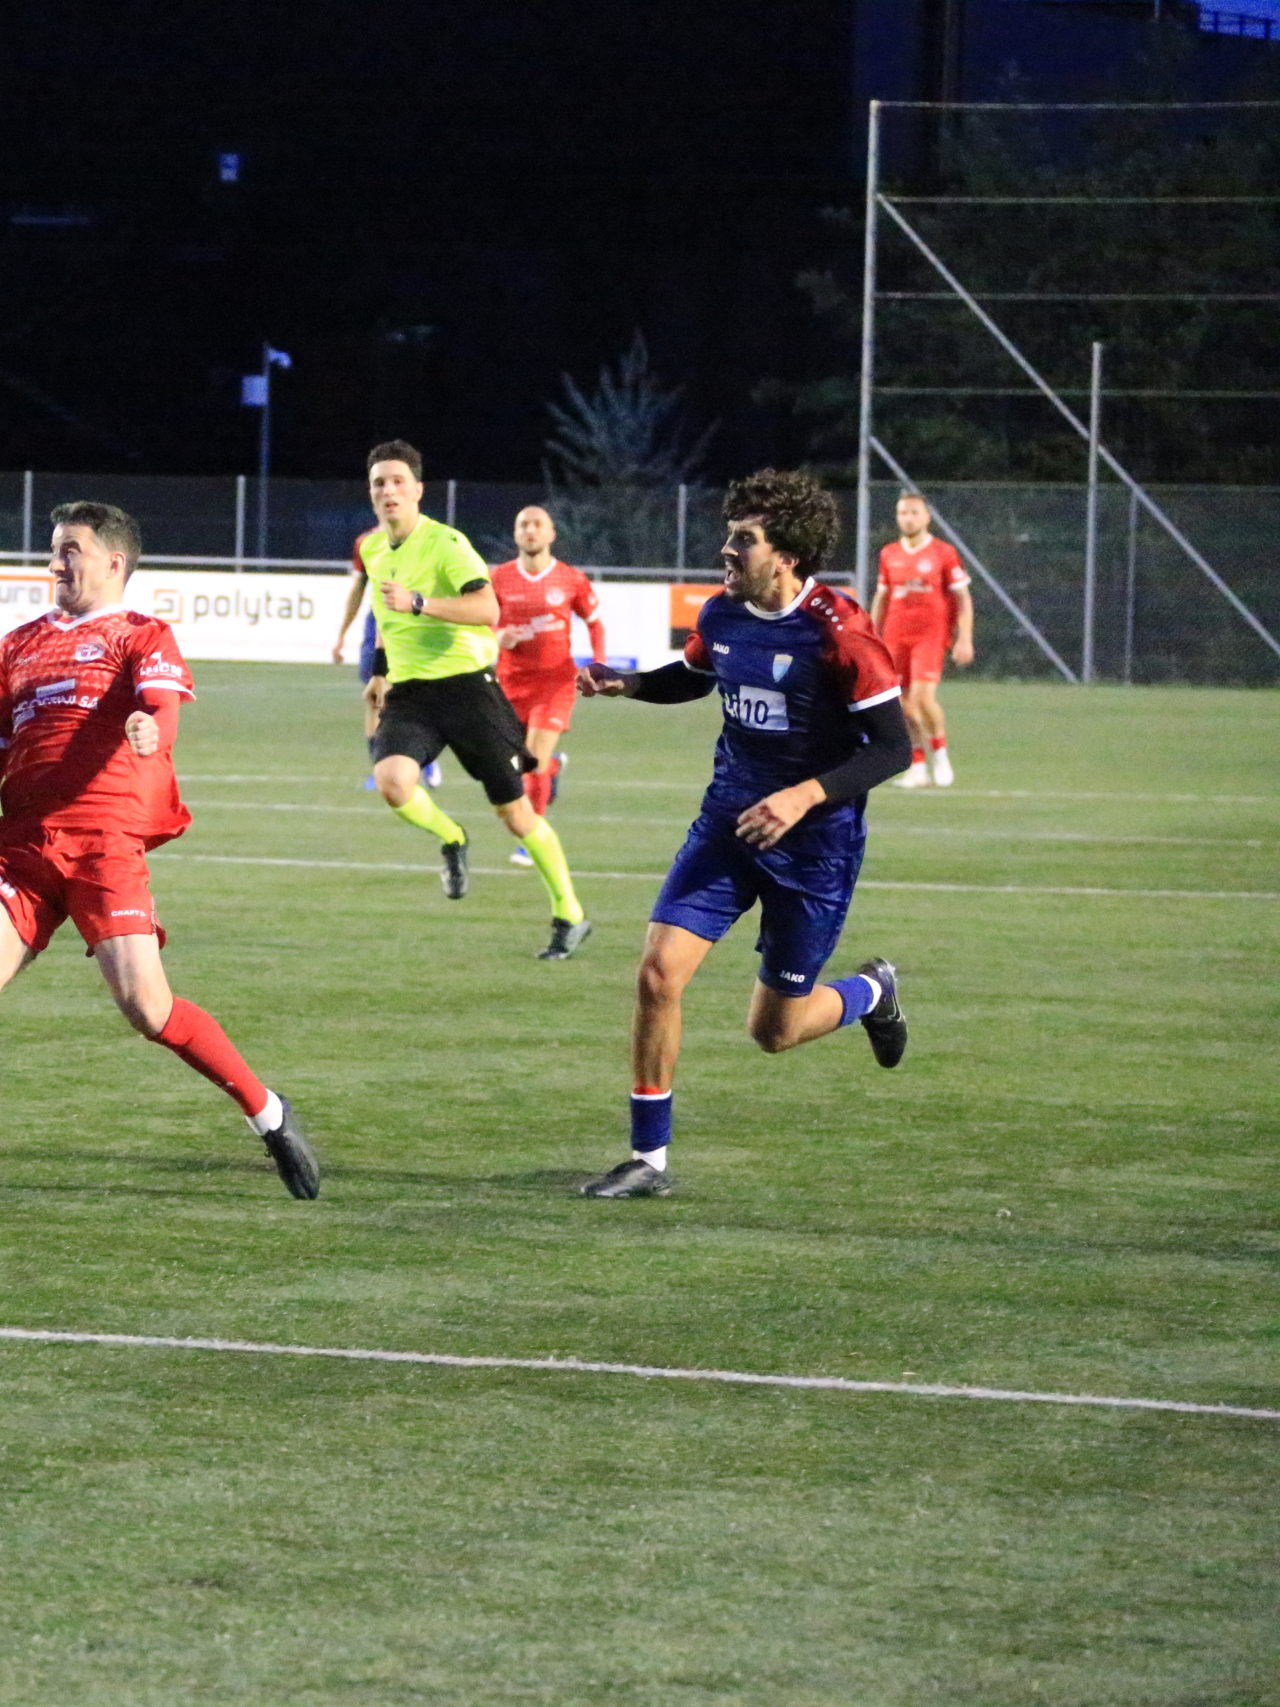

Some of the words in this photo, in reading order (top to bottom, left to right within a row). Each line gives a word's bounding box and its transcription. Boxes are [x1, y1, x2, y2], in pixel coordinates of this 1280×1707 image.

[193, 589, 315, 626] polytab
[712, 642, 730, 655] JAKO
[780, 970, 805, 983] JAKO
